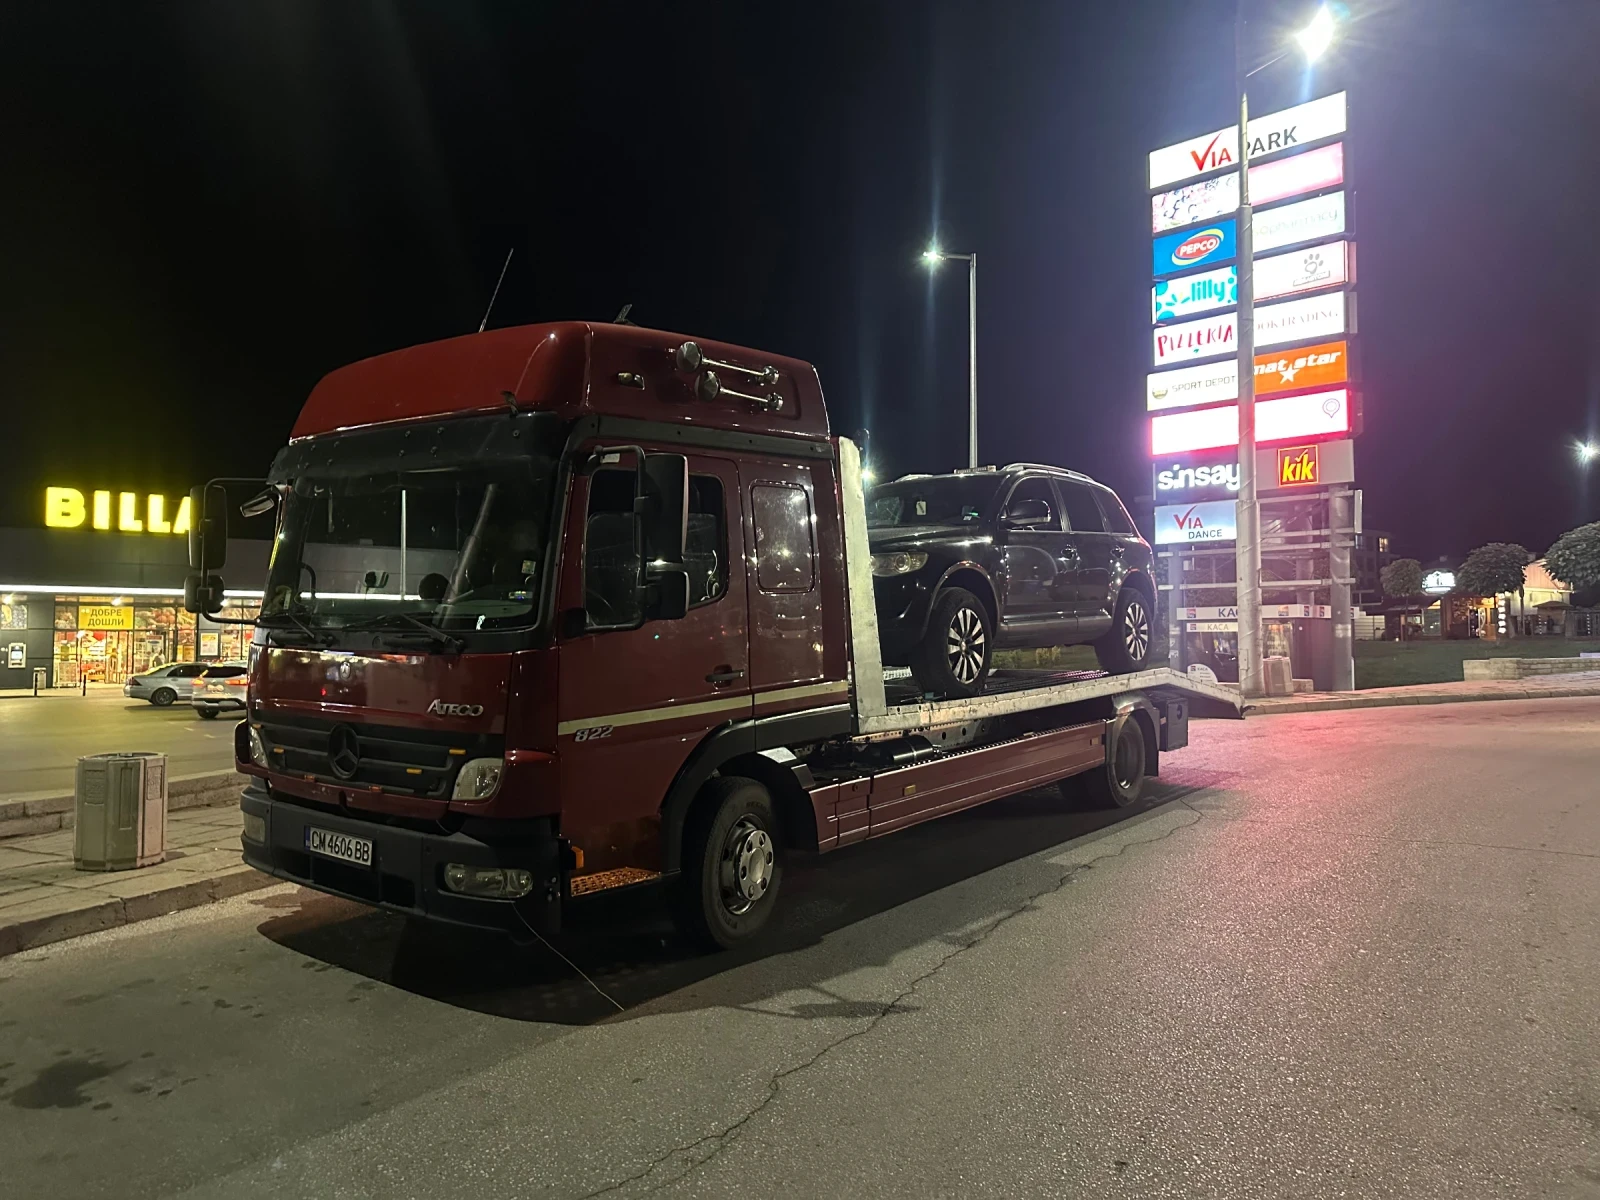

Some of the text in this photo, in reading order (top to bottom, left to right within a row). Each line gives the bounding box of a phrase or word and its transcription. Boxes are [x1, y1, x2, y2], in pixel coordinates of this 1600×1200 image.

[1190, 125, 1298, 171] VIA ARK
[1179, 239, 1216, 256] PEPCO
[1191, 279, 1225, 302] lilly
[1172, 375, 1236, 393] SPORT DEPOT
[1281, 449, 1315, 482] kik
[1157, 463, 1240, 491] sinsay
[1173, 505, 1203, 530] VIA
[1188, 529, 1223, 540] DANCE
[90, 608, 122, 617] ДОБРЕ
[1218, 607, 1238, 618] КА
[88, 618, 124, 627] ДОШЛИ
[574, 725, 614, 742] 822
[327, 835, 353, 858] 4606
[354, 841, 370, 862] BB
